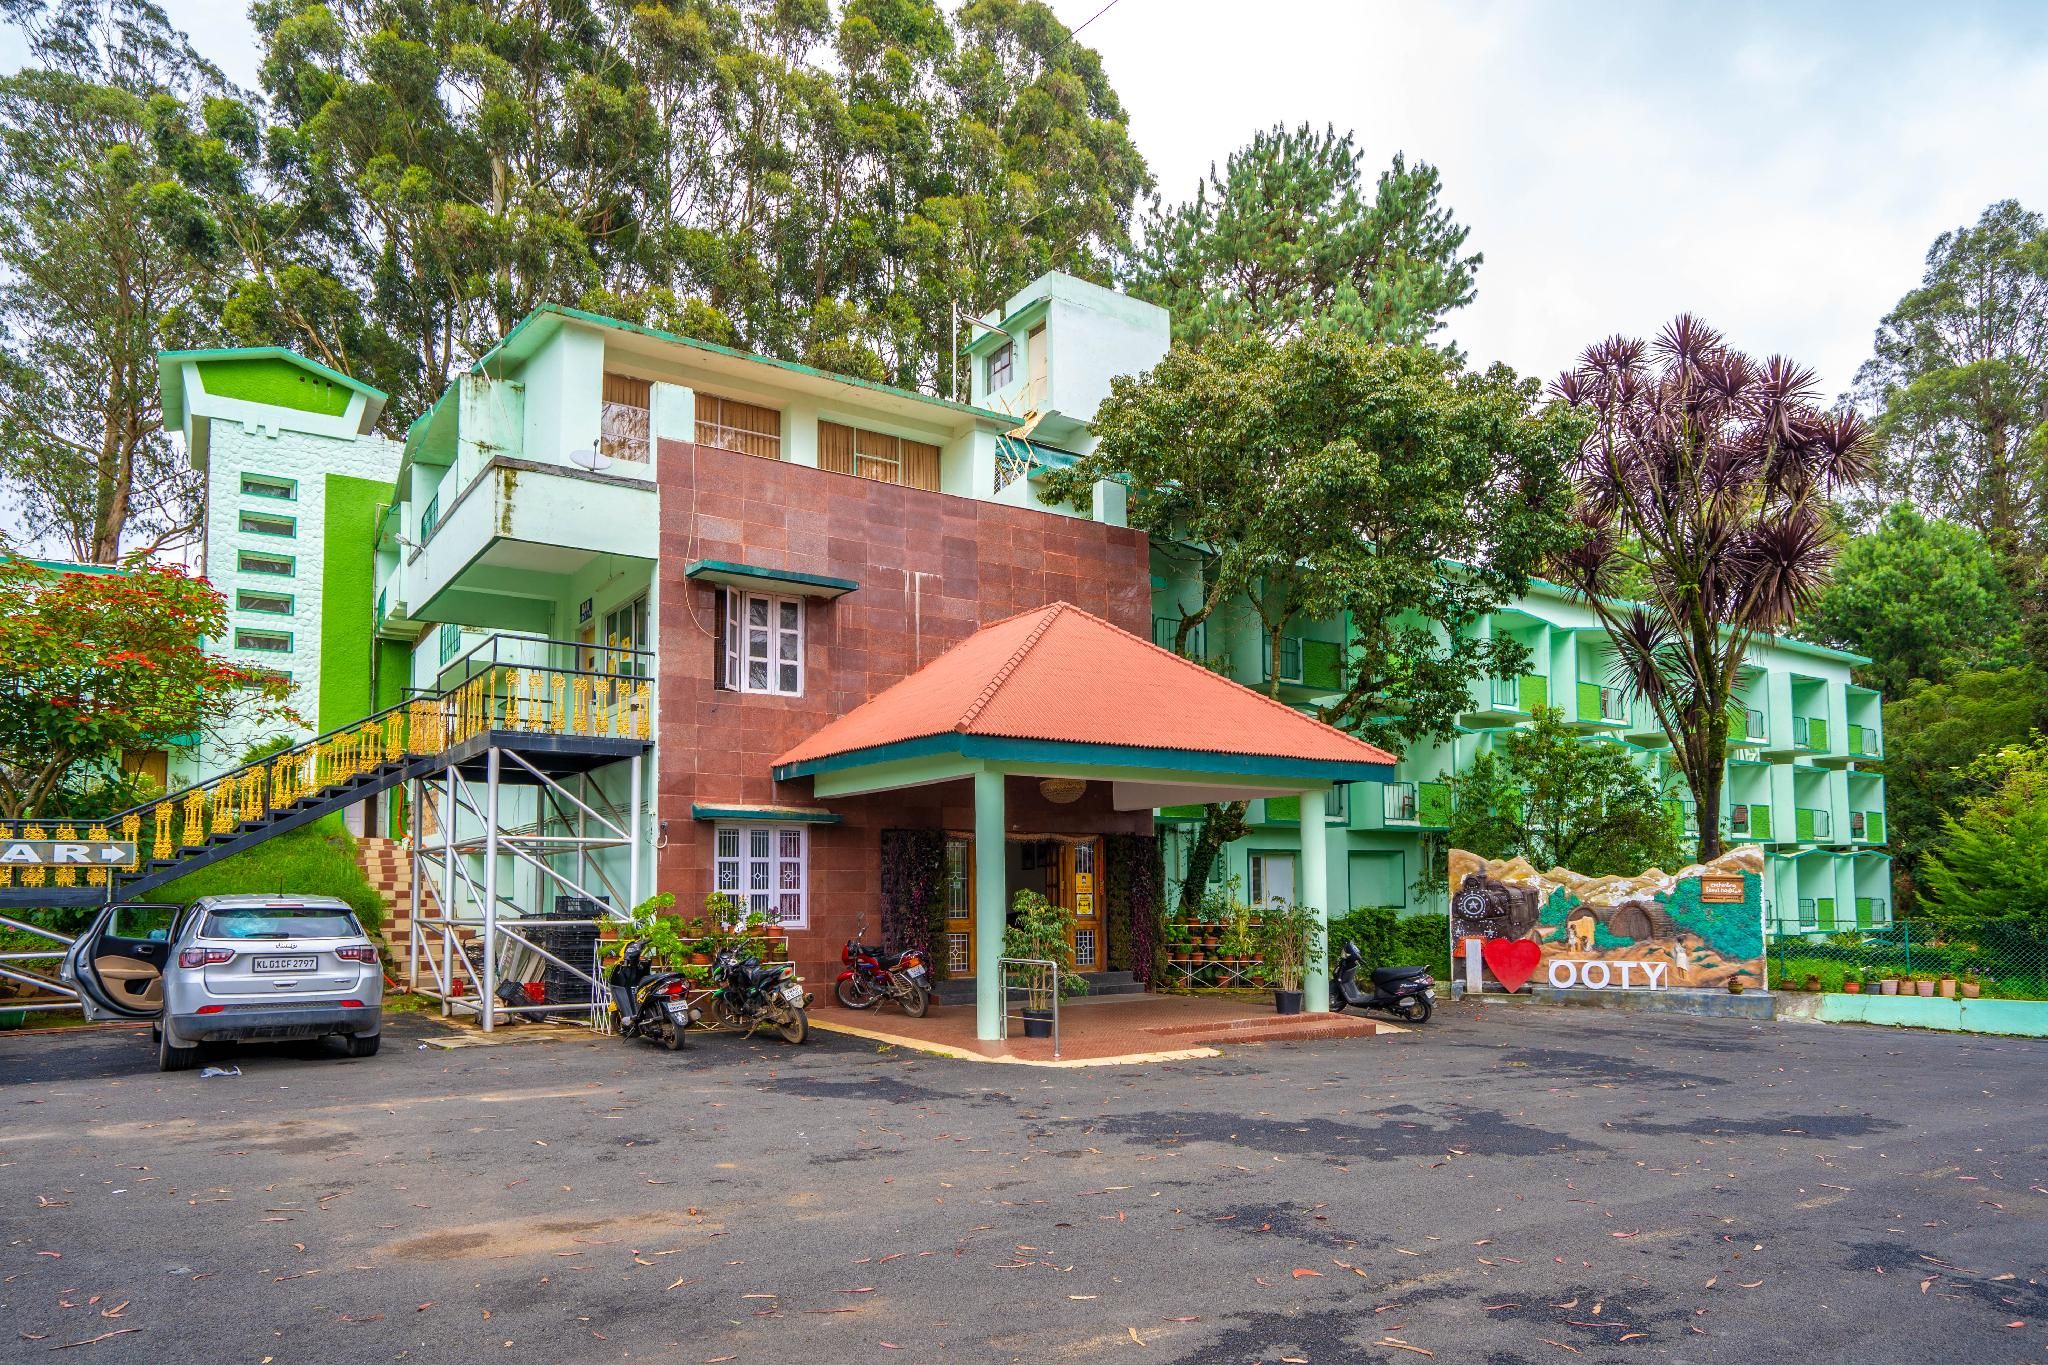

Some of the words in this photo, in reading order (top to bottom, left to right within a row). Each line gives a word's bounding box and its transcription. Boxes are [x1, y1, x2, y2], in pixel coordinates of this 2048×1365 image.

[0, 844, 93, 862] AR
[1465, 939, 1483, 993] I
[1548, 959, 1667, 990] OOTY
